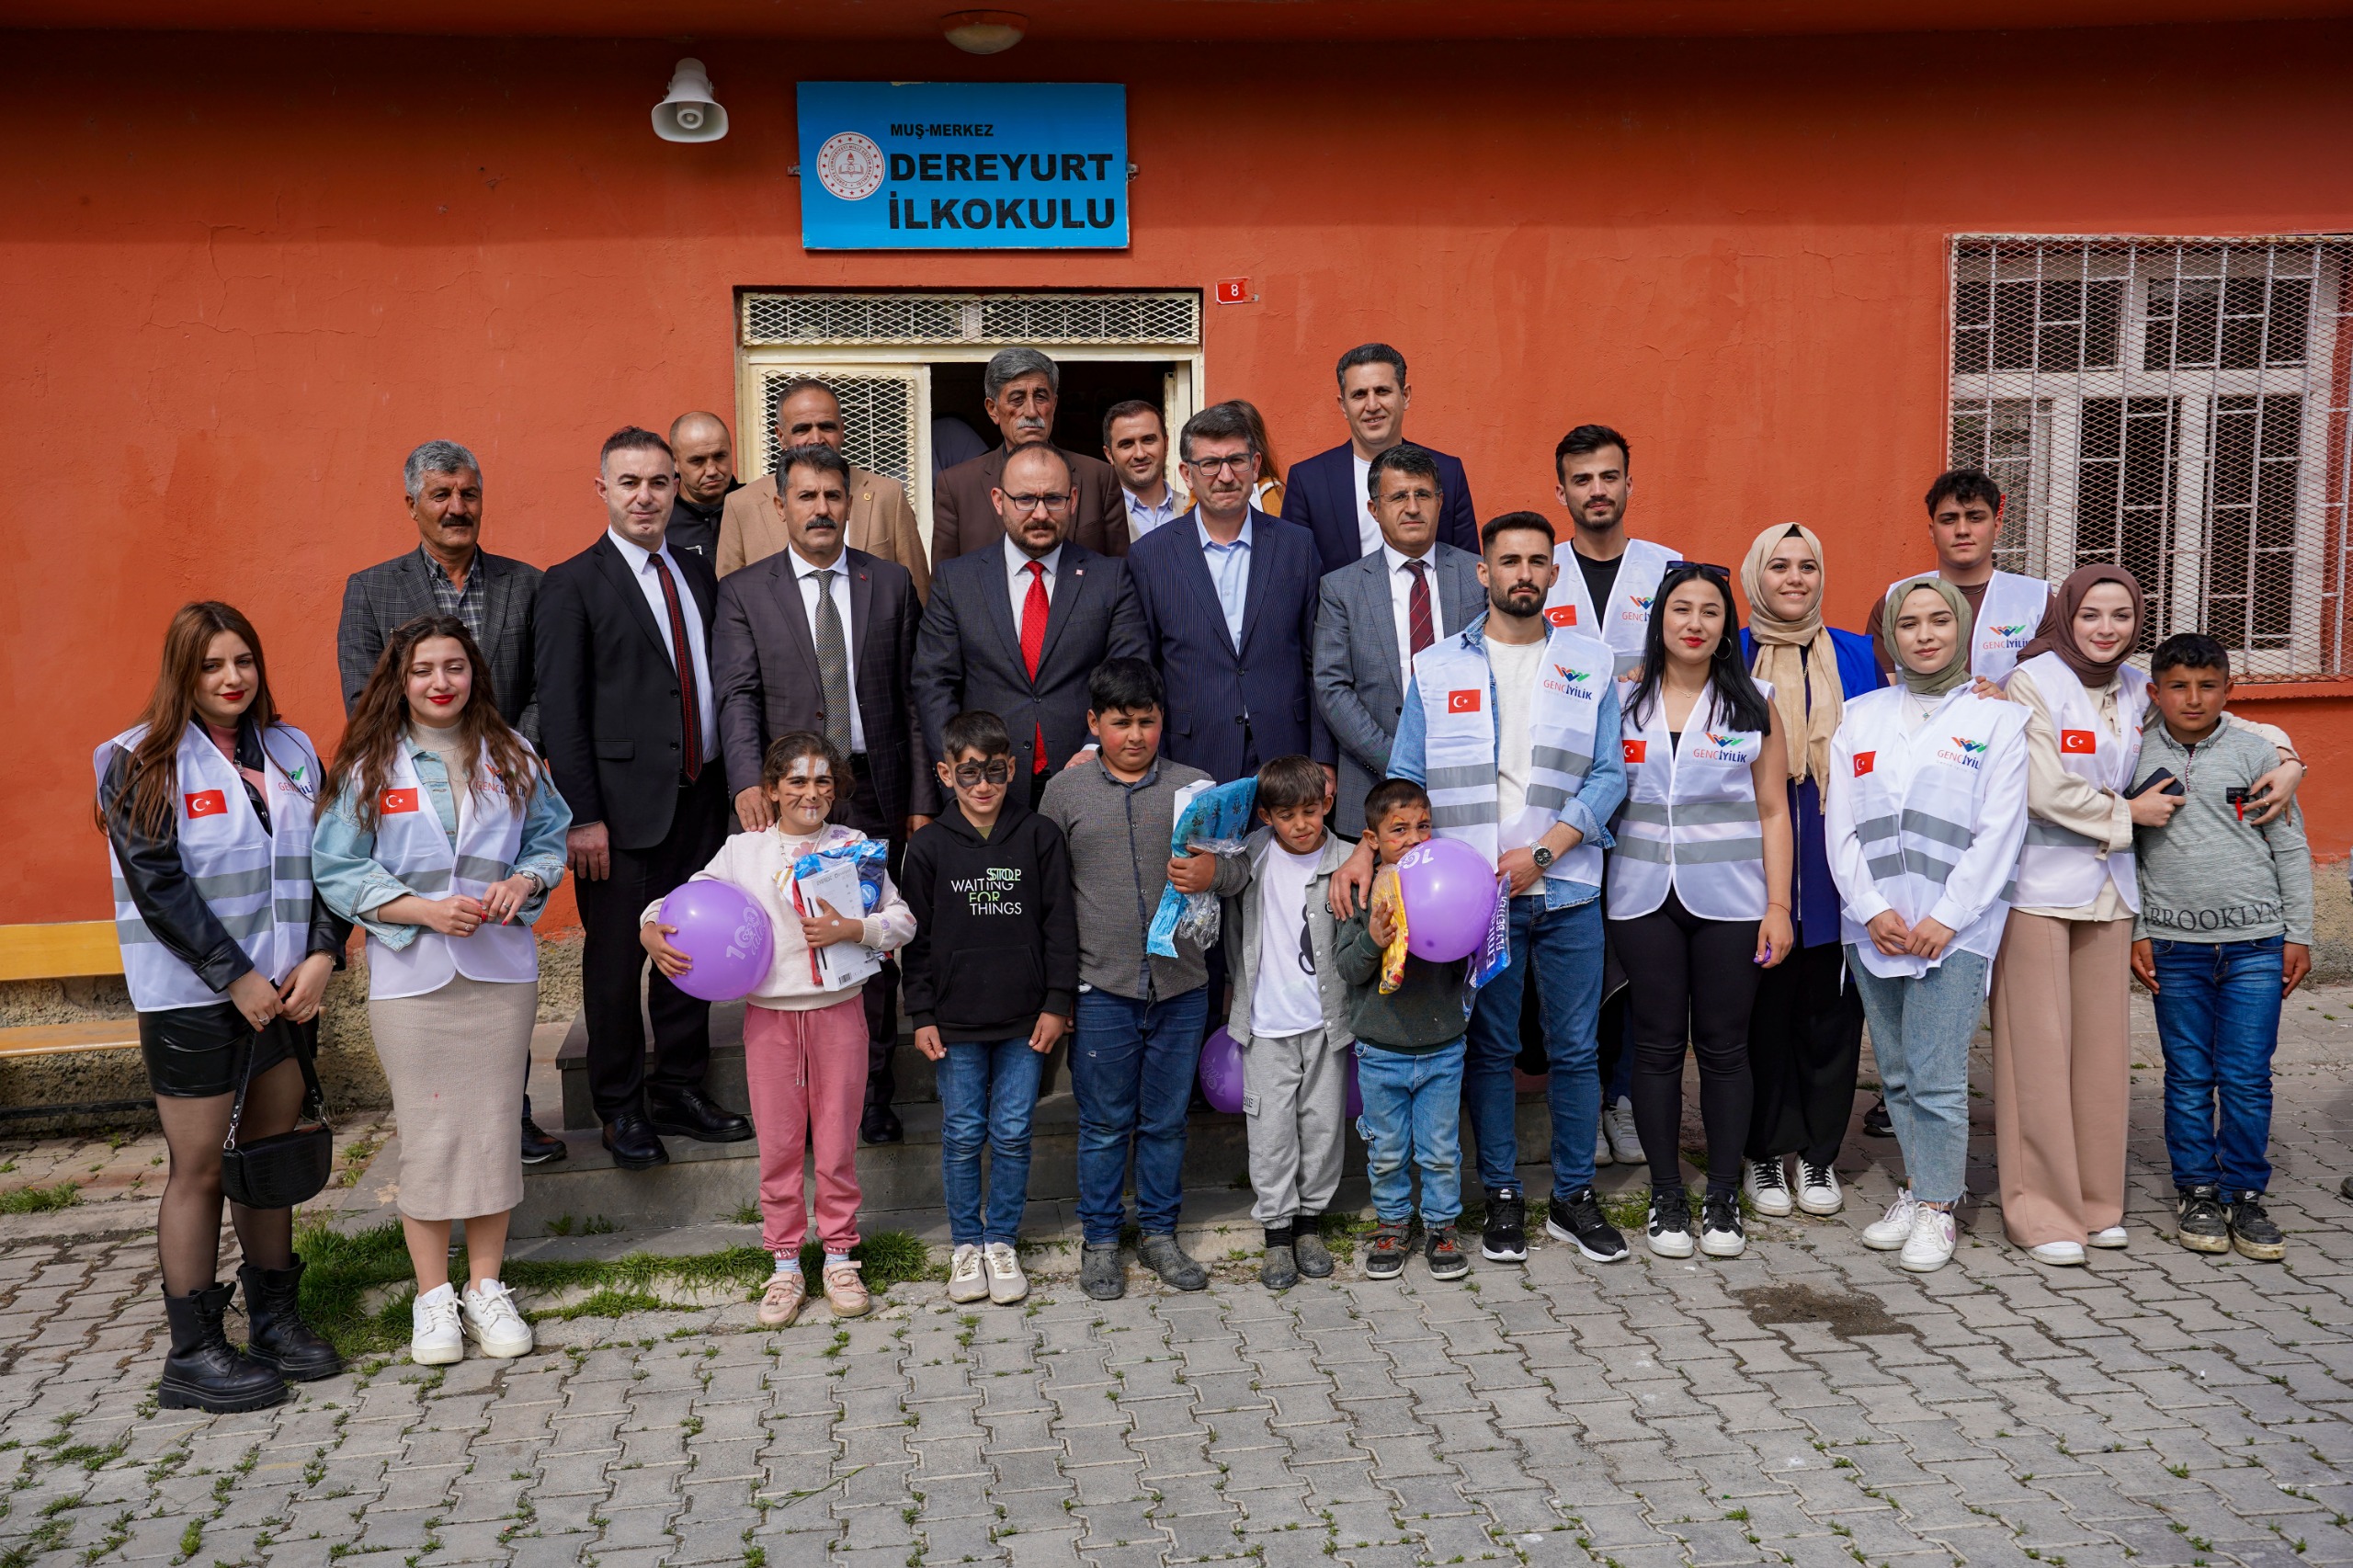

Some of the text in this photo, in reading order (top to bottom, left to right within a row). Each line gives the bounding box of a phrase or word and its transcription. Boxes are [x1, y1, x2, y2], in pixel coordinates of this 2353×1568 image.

[891, 123, 994, 139] MUŞ-MERKEZ
[890, 153, 1113, 181] DEREYURT
[889, 191, 1115, 230] İLKOKULU
[1231, 284, 1239, 297] 8
[950, 878, 1015, 892] WAITING
[969, 891, 1001, 903] FOR
[969, 902, 1022, 915] THINGS
[2150, 901, 2280, 931] BROOKLYN
[1496, 934, 1506, 951] FLY
